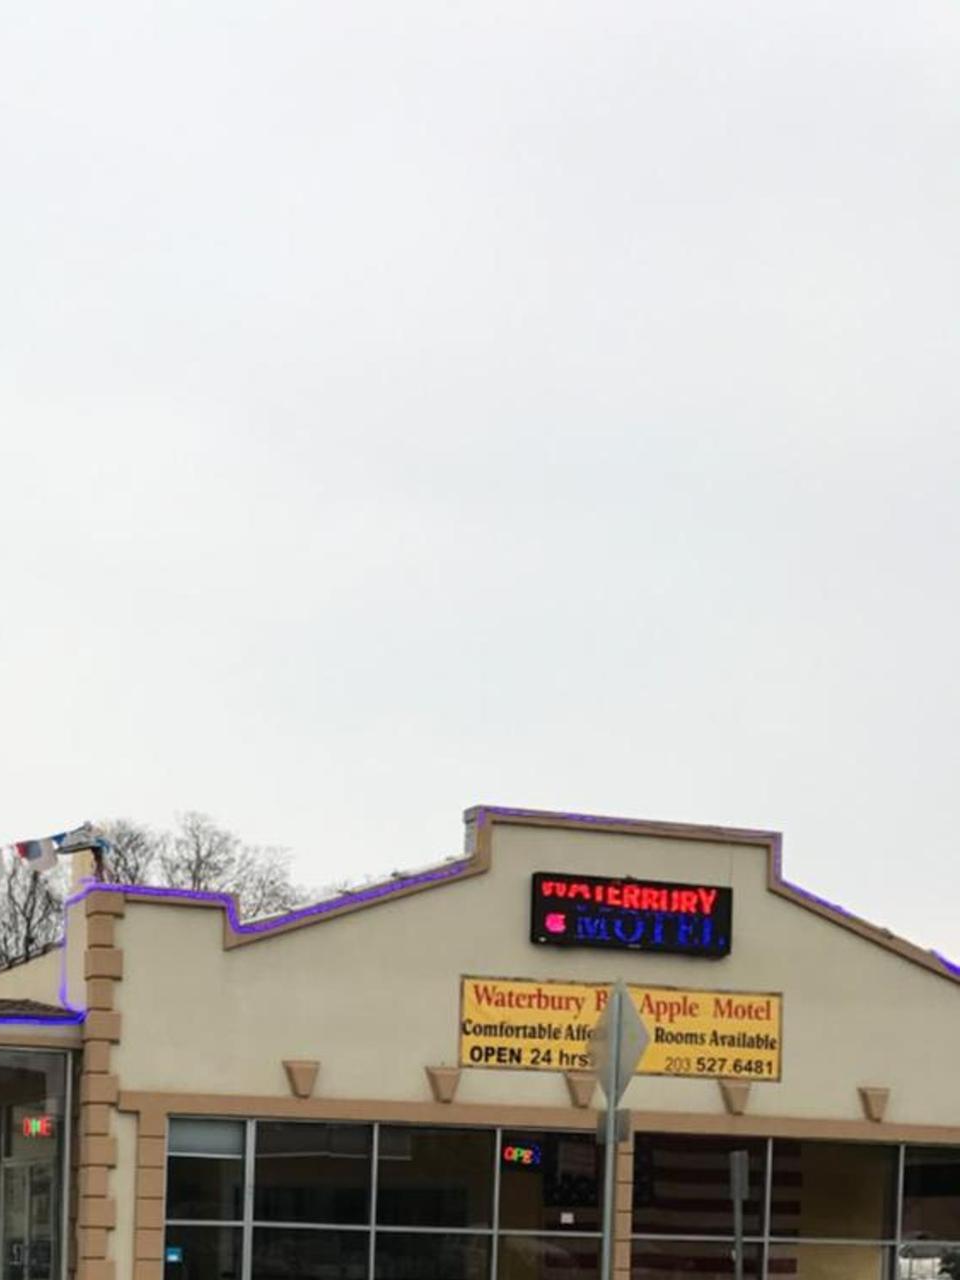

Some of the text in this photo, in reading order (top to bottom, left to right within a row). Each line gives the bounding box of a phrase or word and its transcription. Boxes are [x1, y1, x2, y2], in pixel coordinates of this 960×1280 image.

[541, 881, 717, 915] WATERBURY
[473, 984, 585, 1019] Waterbury
[640, 993, 700, 1023] Apple
[712, 997, 772, 1021] Motel
[461, 1018, 562, 1041] Comfortable
[654, 1026, 777, 1050] Rooms Available
[469, 1046, 522, 1064] OPEN
[530, 1048, 552, 1065] 24
[664, 1056, 774, 1075] 203 527.6481
